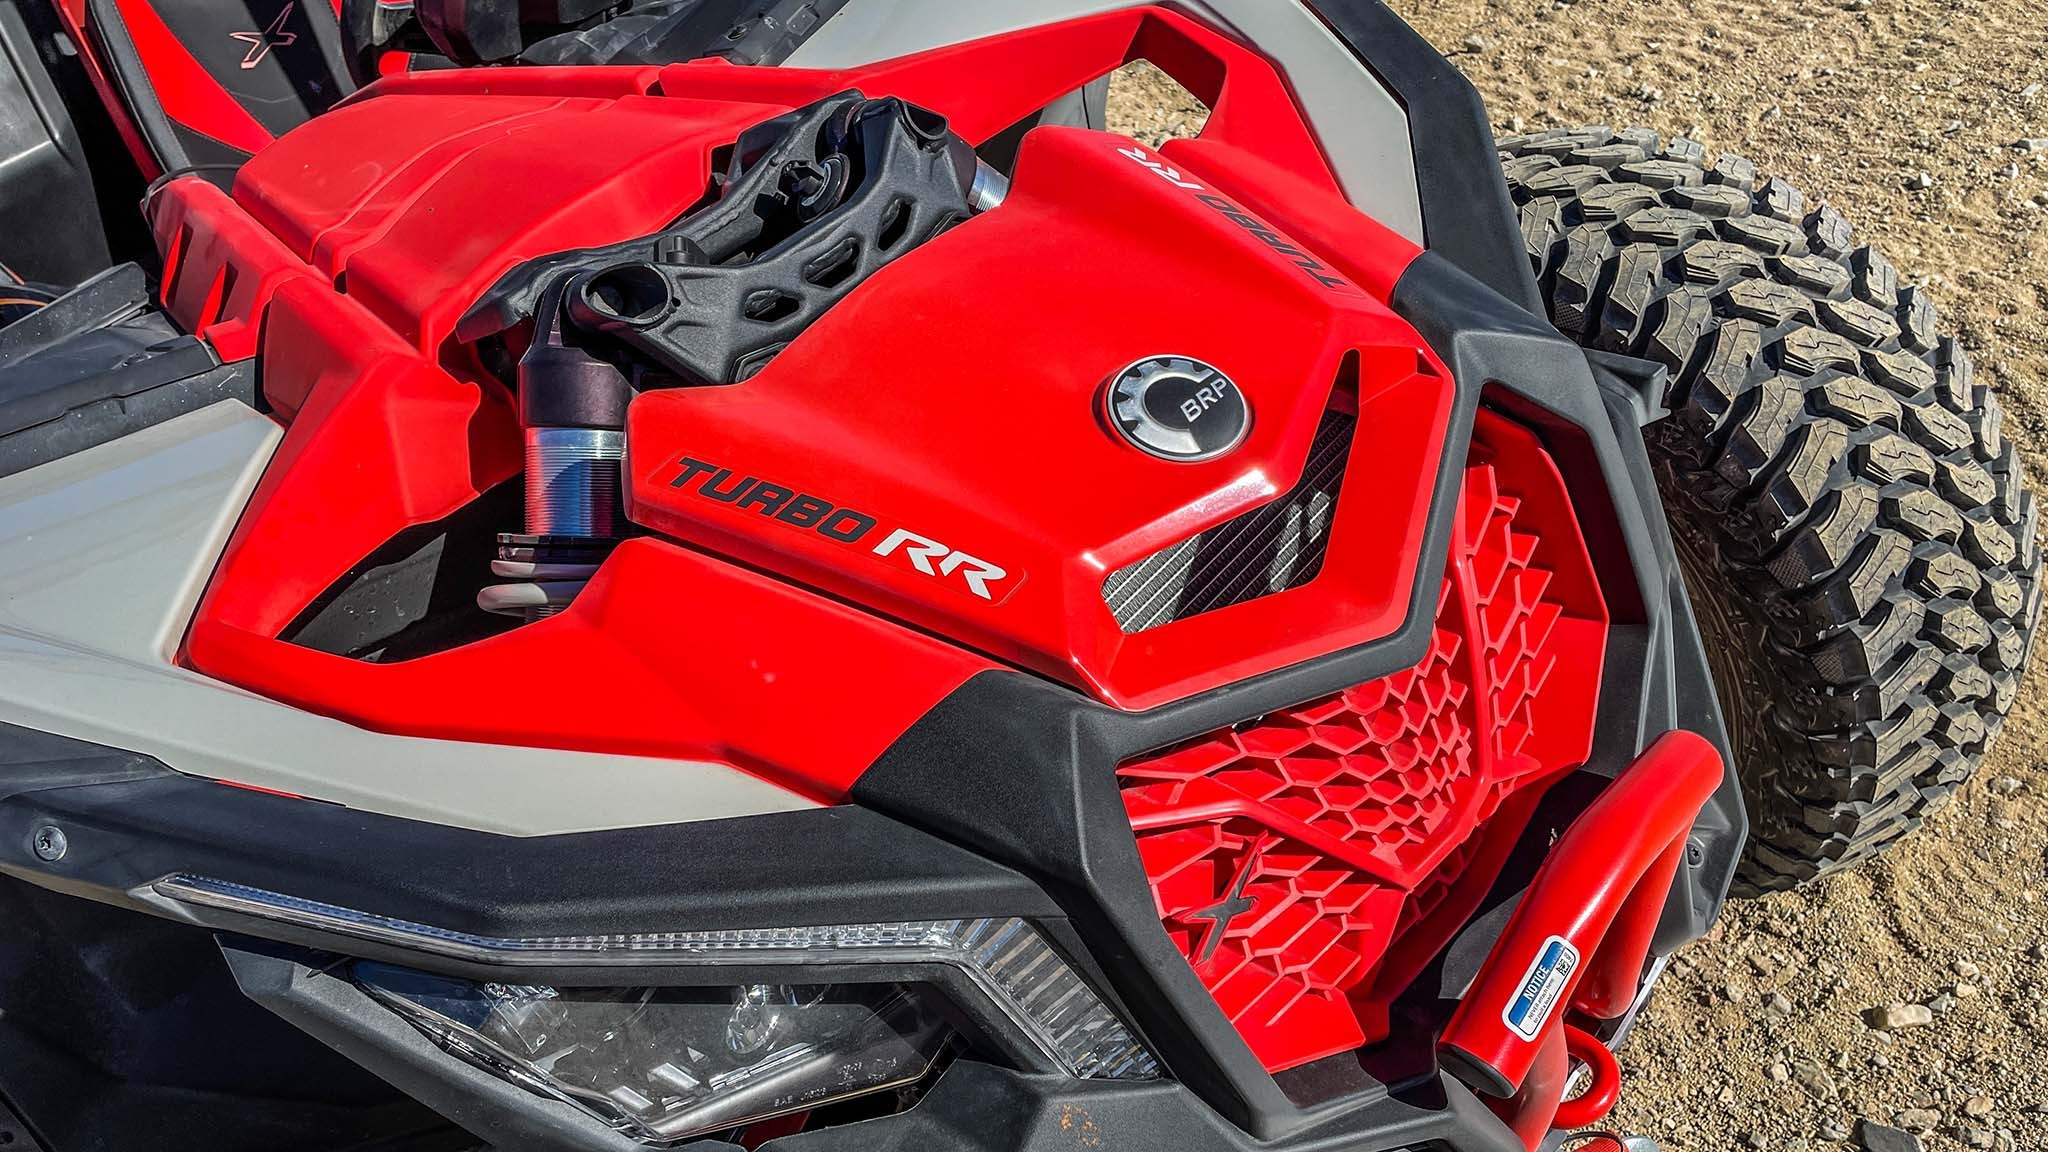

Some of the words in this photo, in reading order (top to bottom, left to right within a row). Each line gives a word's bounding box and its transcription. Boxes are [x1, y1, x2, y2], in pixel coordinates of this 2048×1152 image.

[1116, 147, 1205, 190] RR
[1195, 194, 1346, 288] TURBO
[1180, 377, 1227, 423] BRP
[670, 457, 877, 543] TURBO
[872, 528, 1006, 600] RR
[1522, 965, 1550, 1001] NOTICE
[1528, 1003, 1540, 1019] NEVER
